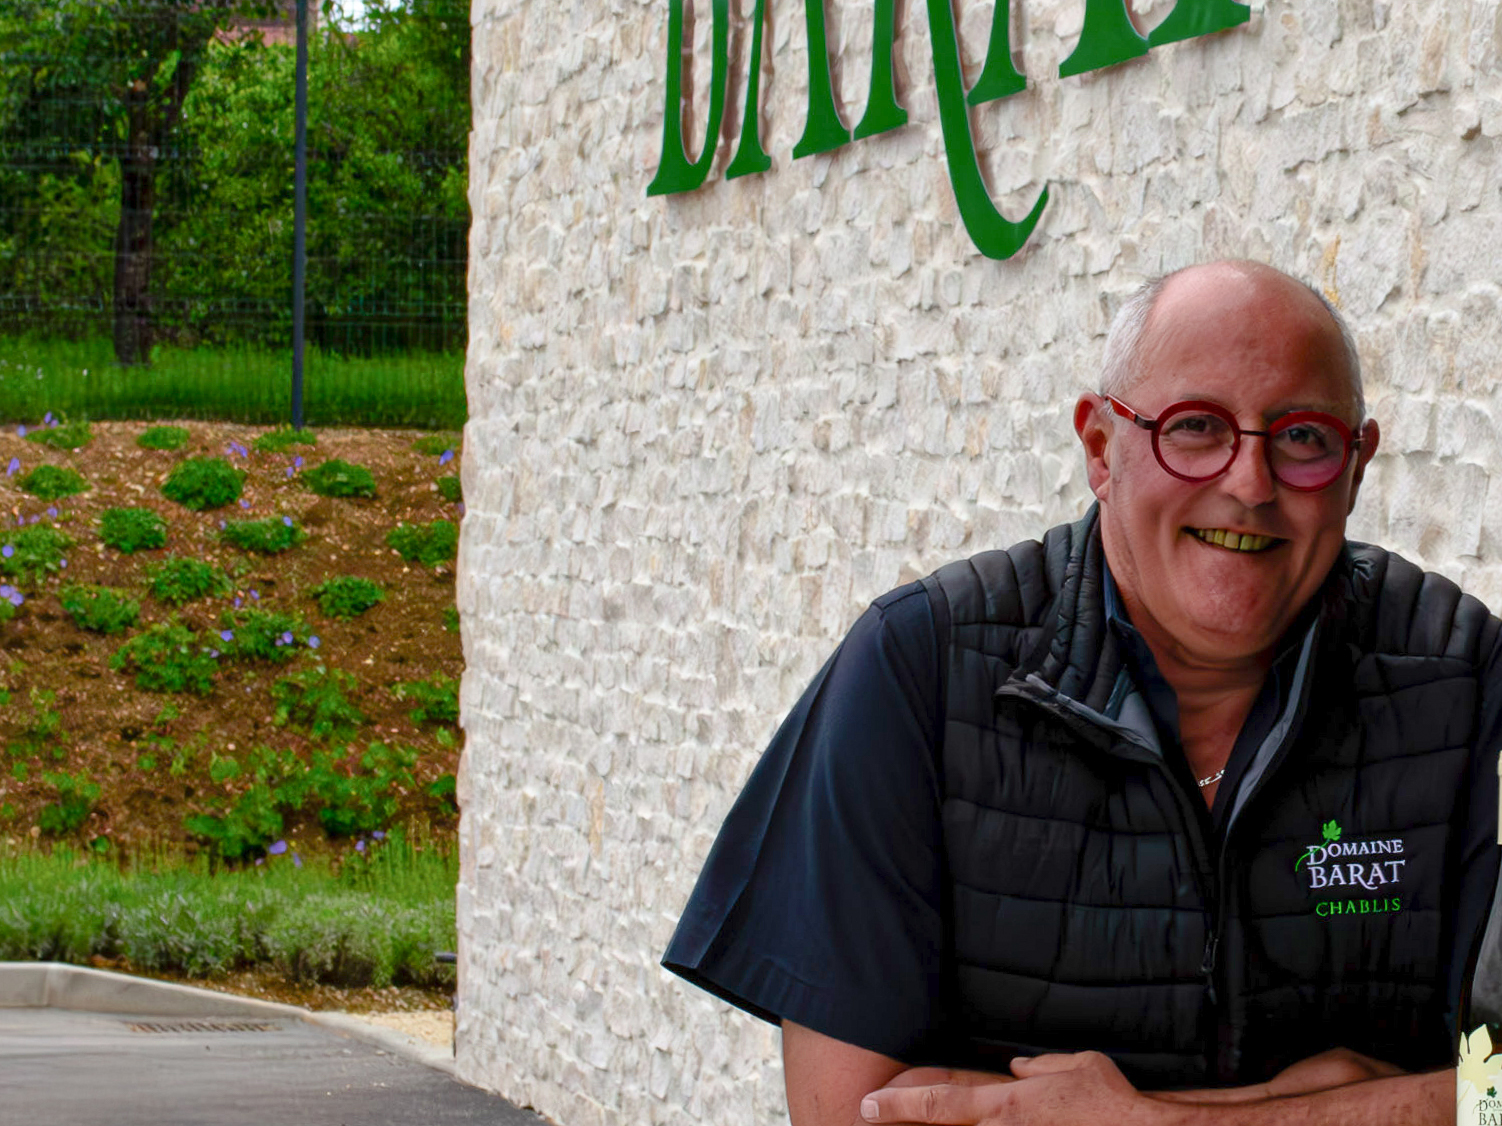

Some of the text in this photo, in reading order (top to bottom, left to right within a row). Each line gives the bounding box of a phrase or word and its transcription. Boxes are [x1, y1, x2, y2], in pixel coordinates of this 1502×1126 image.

[1306, 839, 1404, 866] DOMAINE
[1308, 860, 1406, 890] BARAT
[1316, 898, 1401, 917] CHABLIS
